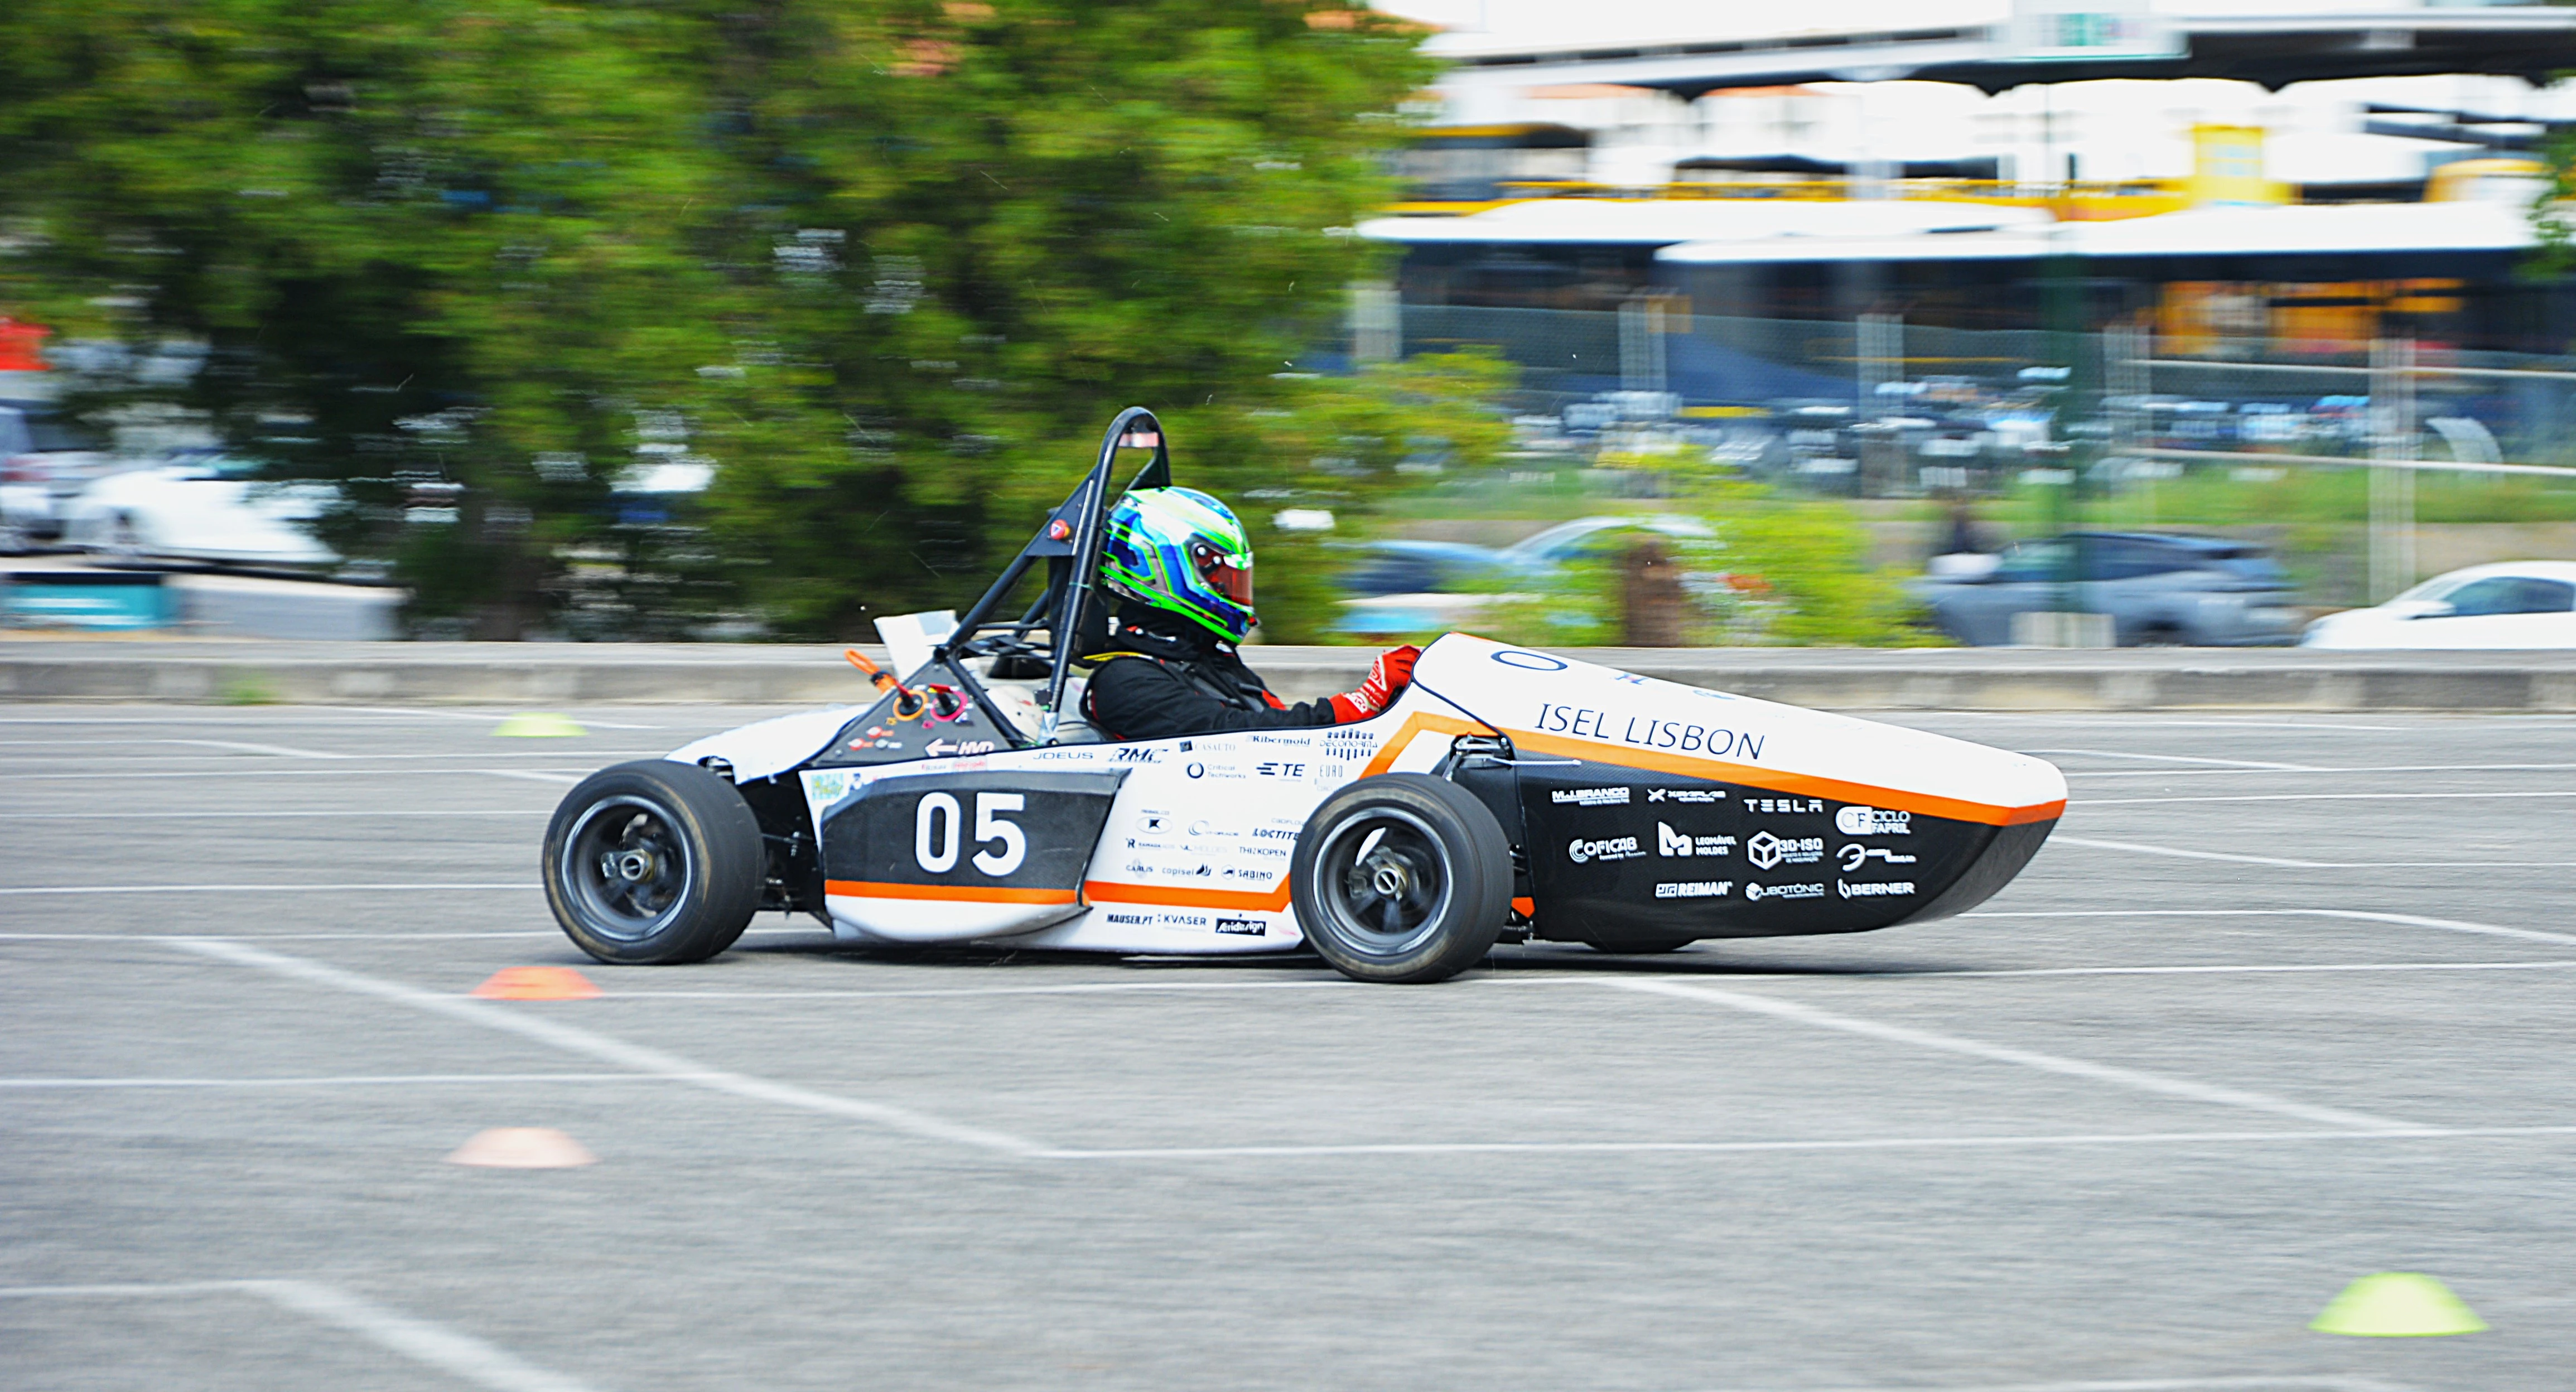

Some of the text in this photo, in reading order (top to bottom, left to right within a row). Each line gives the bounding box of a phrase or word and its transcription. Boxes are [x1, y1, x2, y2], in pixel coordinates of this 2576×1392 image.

[1535, 703, 1765, 760] ISEL LISBON
[1109, 748, 1168, 763] RMC
[1283, 763, 1305, 777] TE
[1320, 765, 1343, 777] EURO
[1744, 799, 1823, 813] TESLA
[1871, 810, 1911, 823] CICLO
[916, 792, 1026, 877] 05
[1252, 828, 1300, 840] LOCTITE
[1871, 823, 1911, 834] FAPRIL
[1569, 837, 1637, 863] COFICAB
[1696, 846, 1728, 856] MOLDES
[1162, 867, 1194, 876] copisel
[1238, 869, 1272, 879] SABINO
[1677, 882, 1729, 897] REIMAN
[1851, 882, 1914, 895] BERNER
[1107, 914, 1153, 925] MAUSER.PT
[1164, 915, 1207, 925] KVASER
